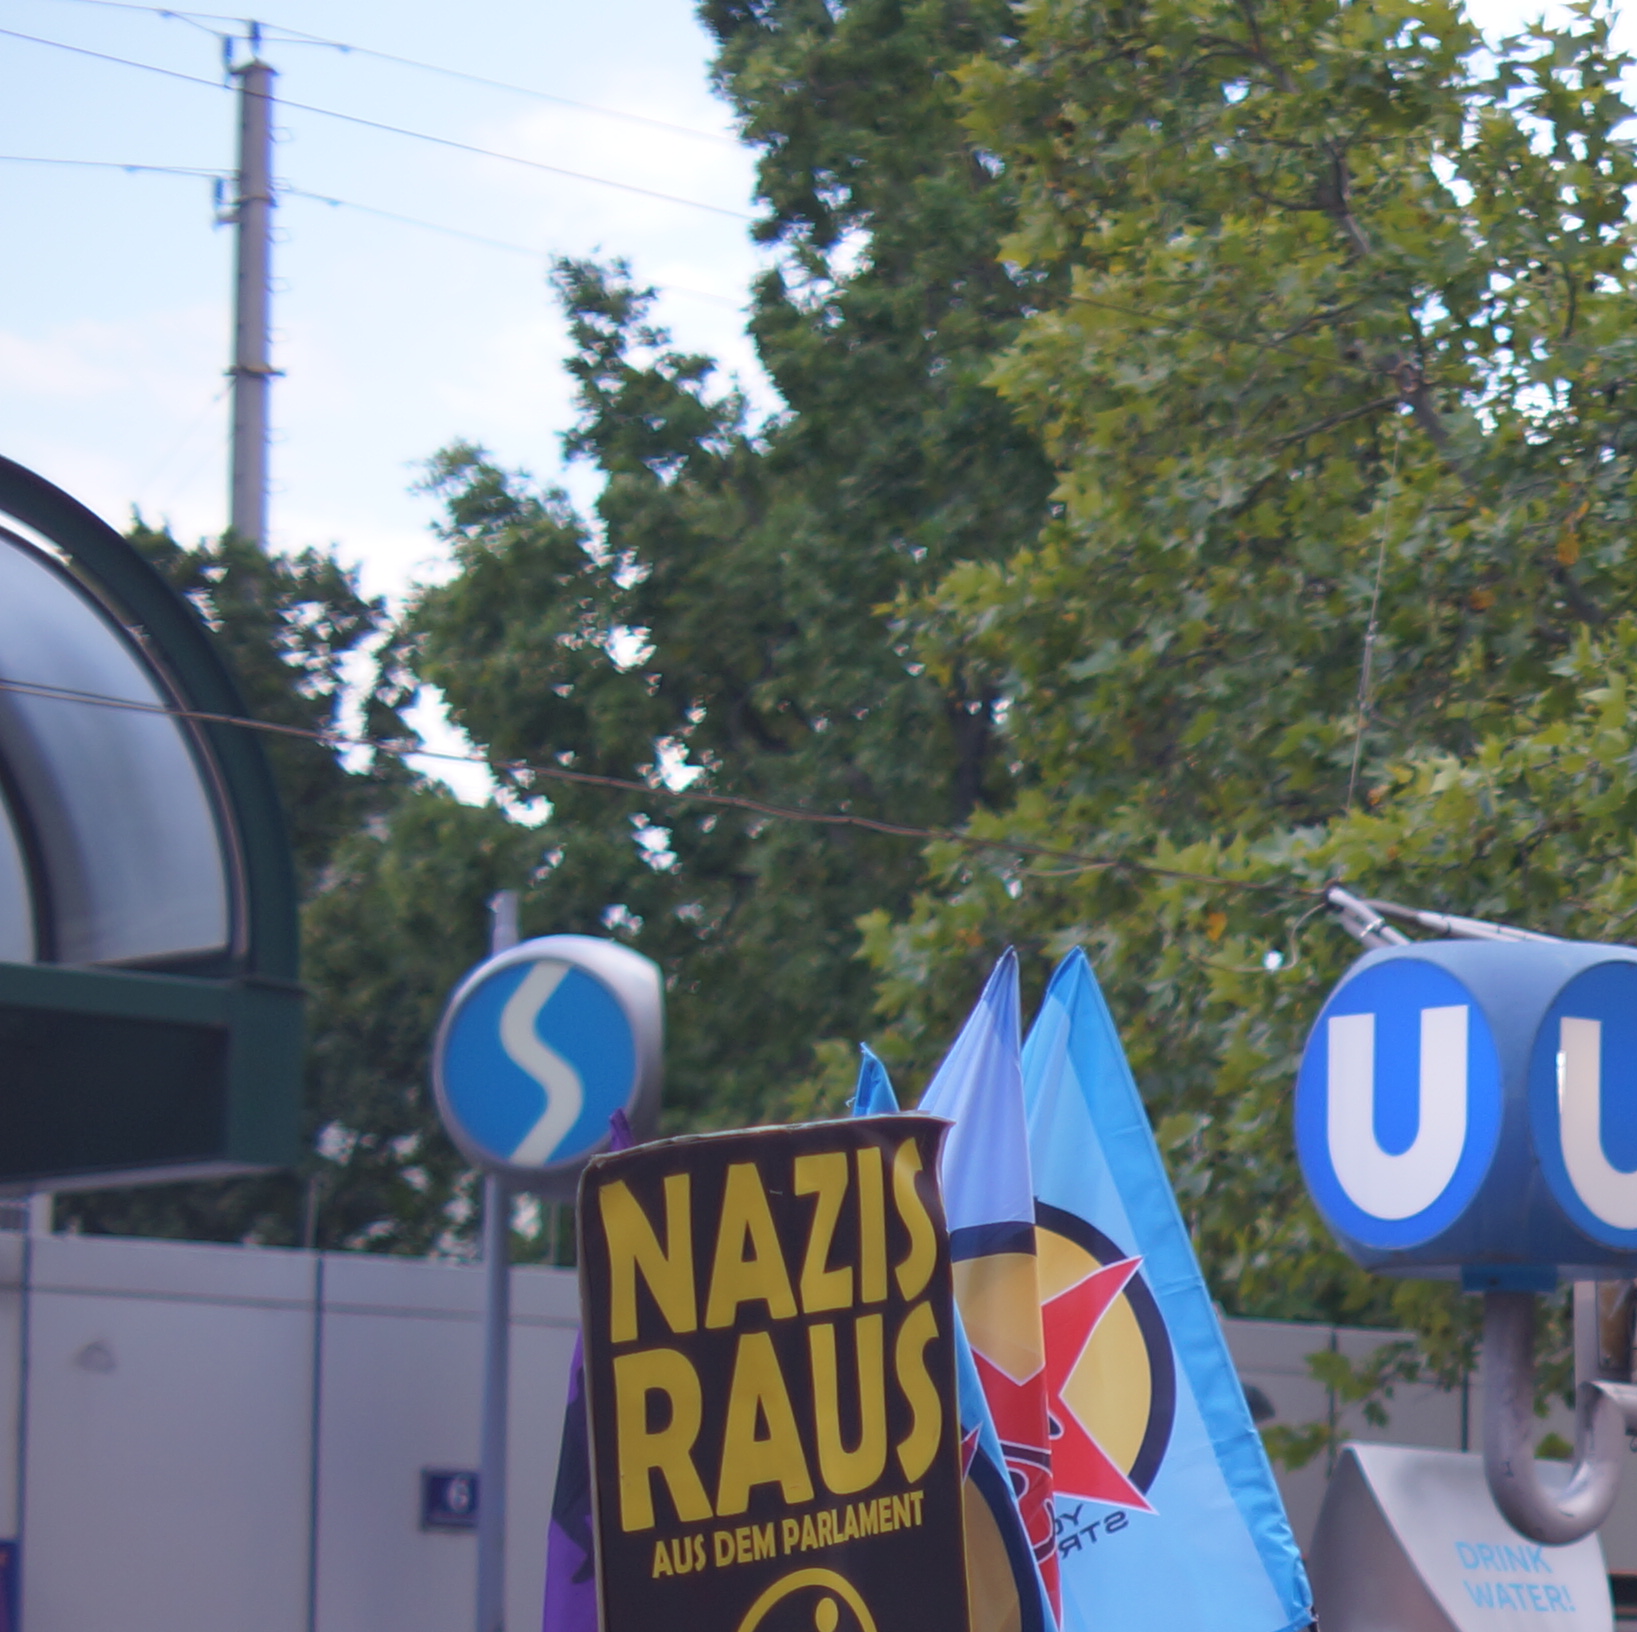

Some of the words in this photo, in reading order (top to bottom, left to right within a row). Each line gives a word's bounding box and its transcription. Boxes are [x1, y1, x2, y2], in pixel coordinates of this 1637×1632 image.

[1327, 1005, 1468, 1220] U
[600, 1137, 937, 1343] NAZIS
[613, 1301, 942, 1532] RAUS
[652, 1534, 706, 1578] AUS
[715, 1521, 776, 1567] DEM
[784, 1491, 924, 1554] PARLAMENT
[1455, 1541, 1554, 1574] DRINK
[1463, 1580, 1576, 1613] WATER!
